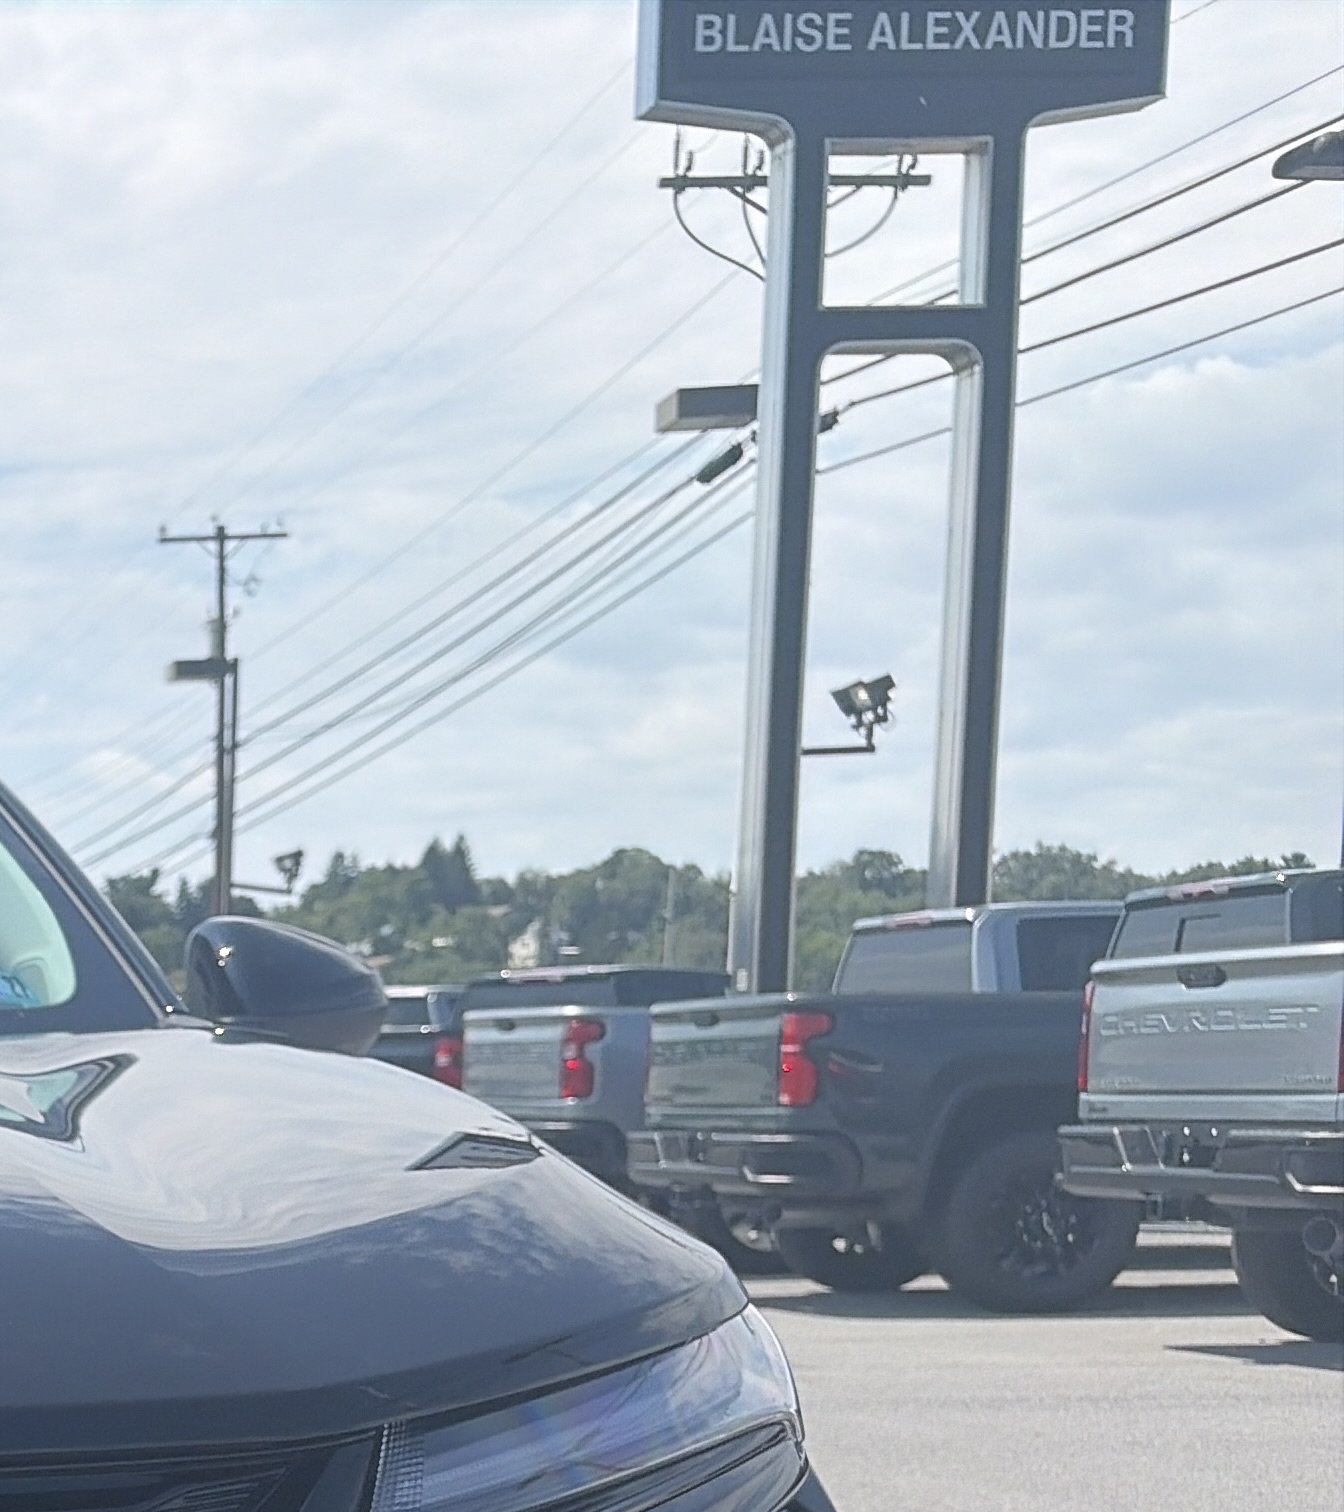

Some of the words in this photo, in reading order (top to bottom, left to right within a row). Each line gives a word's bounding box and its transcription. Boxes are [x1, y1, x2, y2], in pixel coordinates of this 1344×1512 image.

[694, 12, 853, 53] BLAISE
[866, 8, 1136, 51] ALEXANDER
[1099, 1003, 1320, 1037] CHEVROLET
